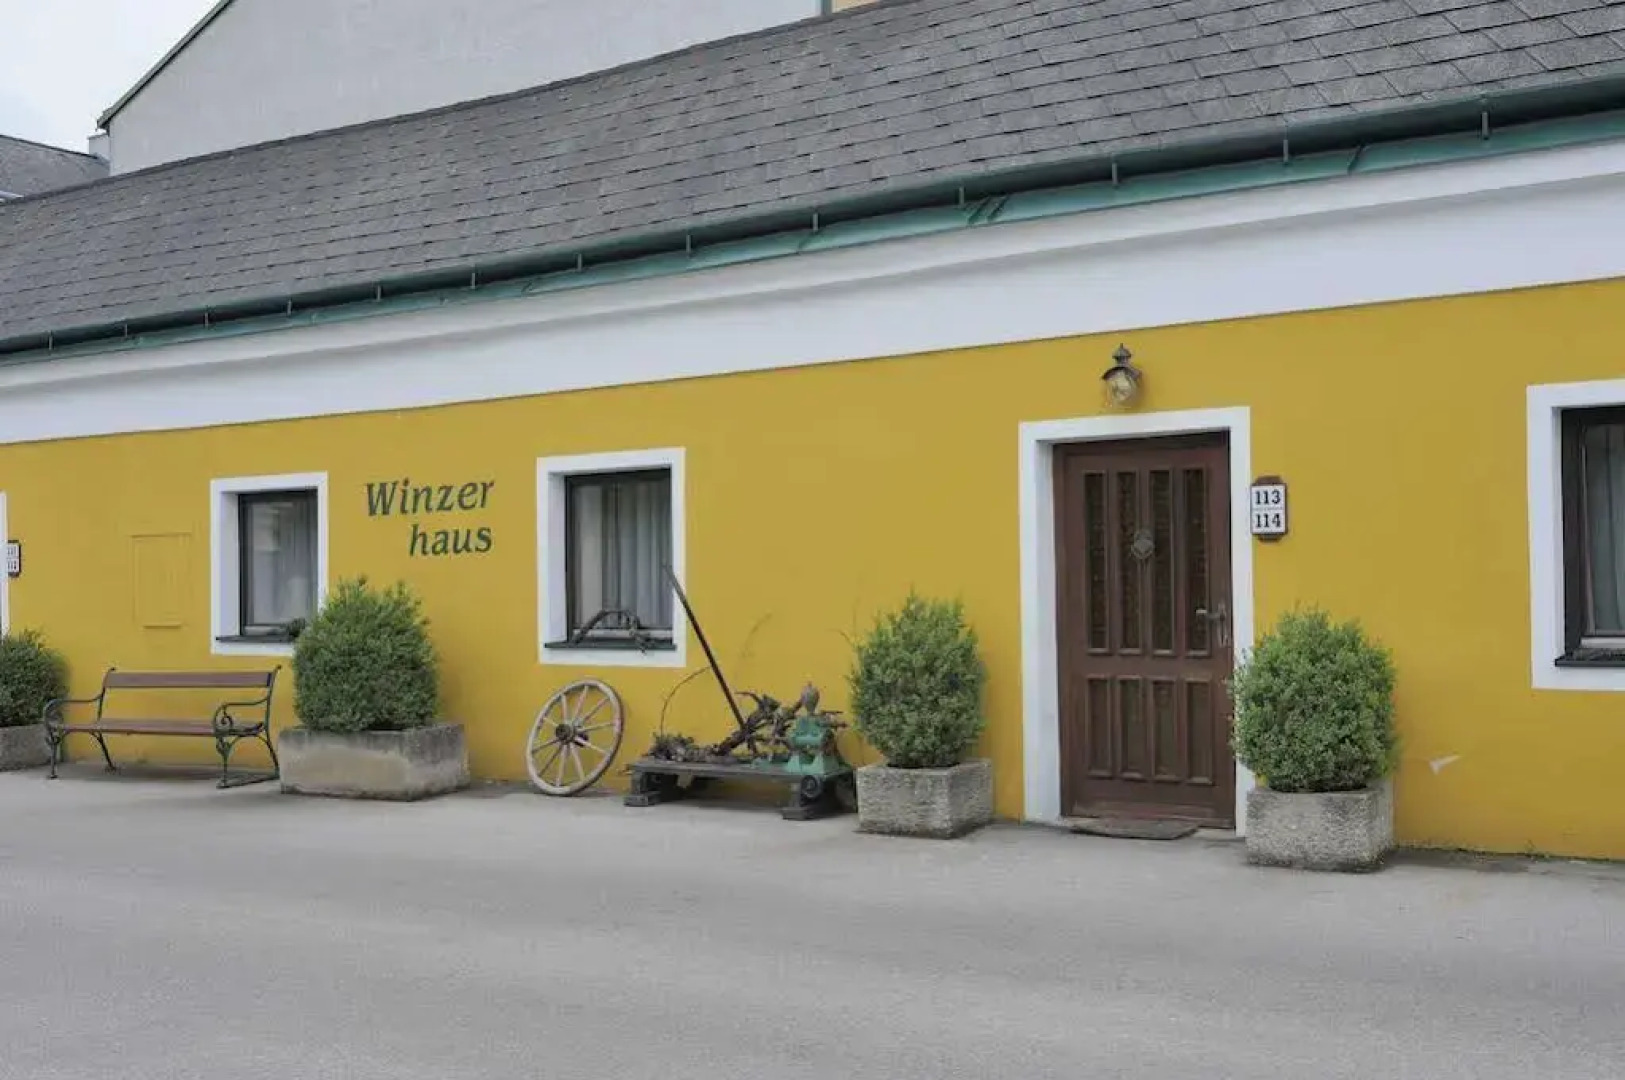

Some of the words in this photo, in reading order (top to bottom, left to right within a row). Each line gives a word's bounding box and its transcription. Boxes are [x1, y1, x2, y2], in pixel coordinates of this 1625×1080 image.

[366, 477, 495, 517] Winzer
[1255, 489, 1281, 505] 113
[1255, 513, 1281, 528] 114
[409, 523, 493, 557] haus
